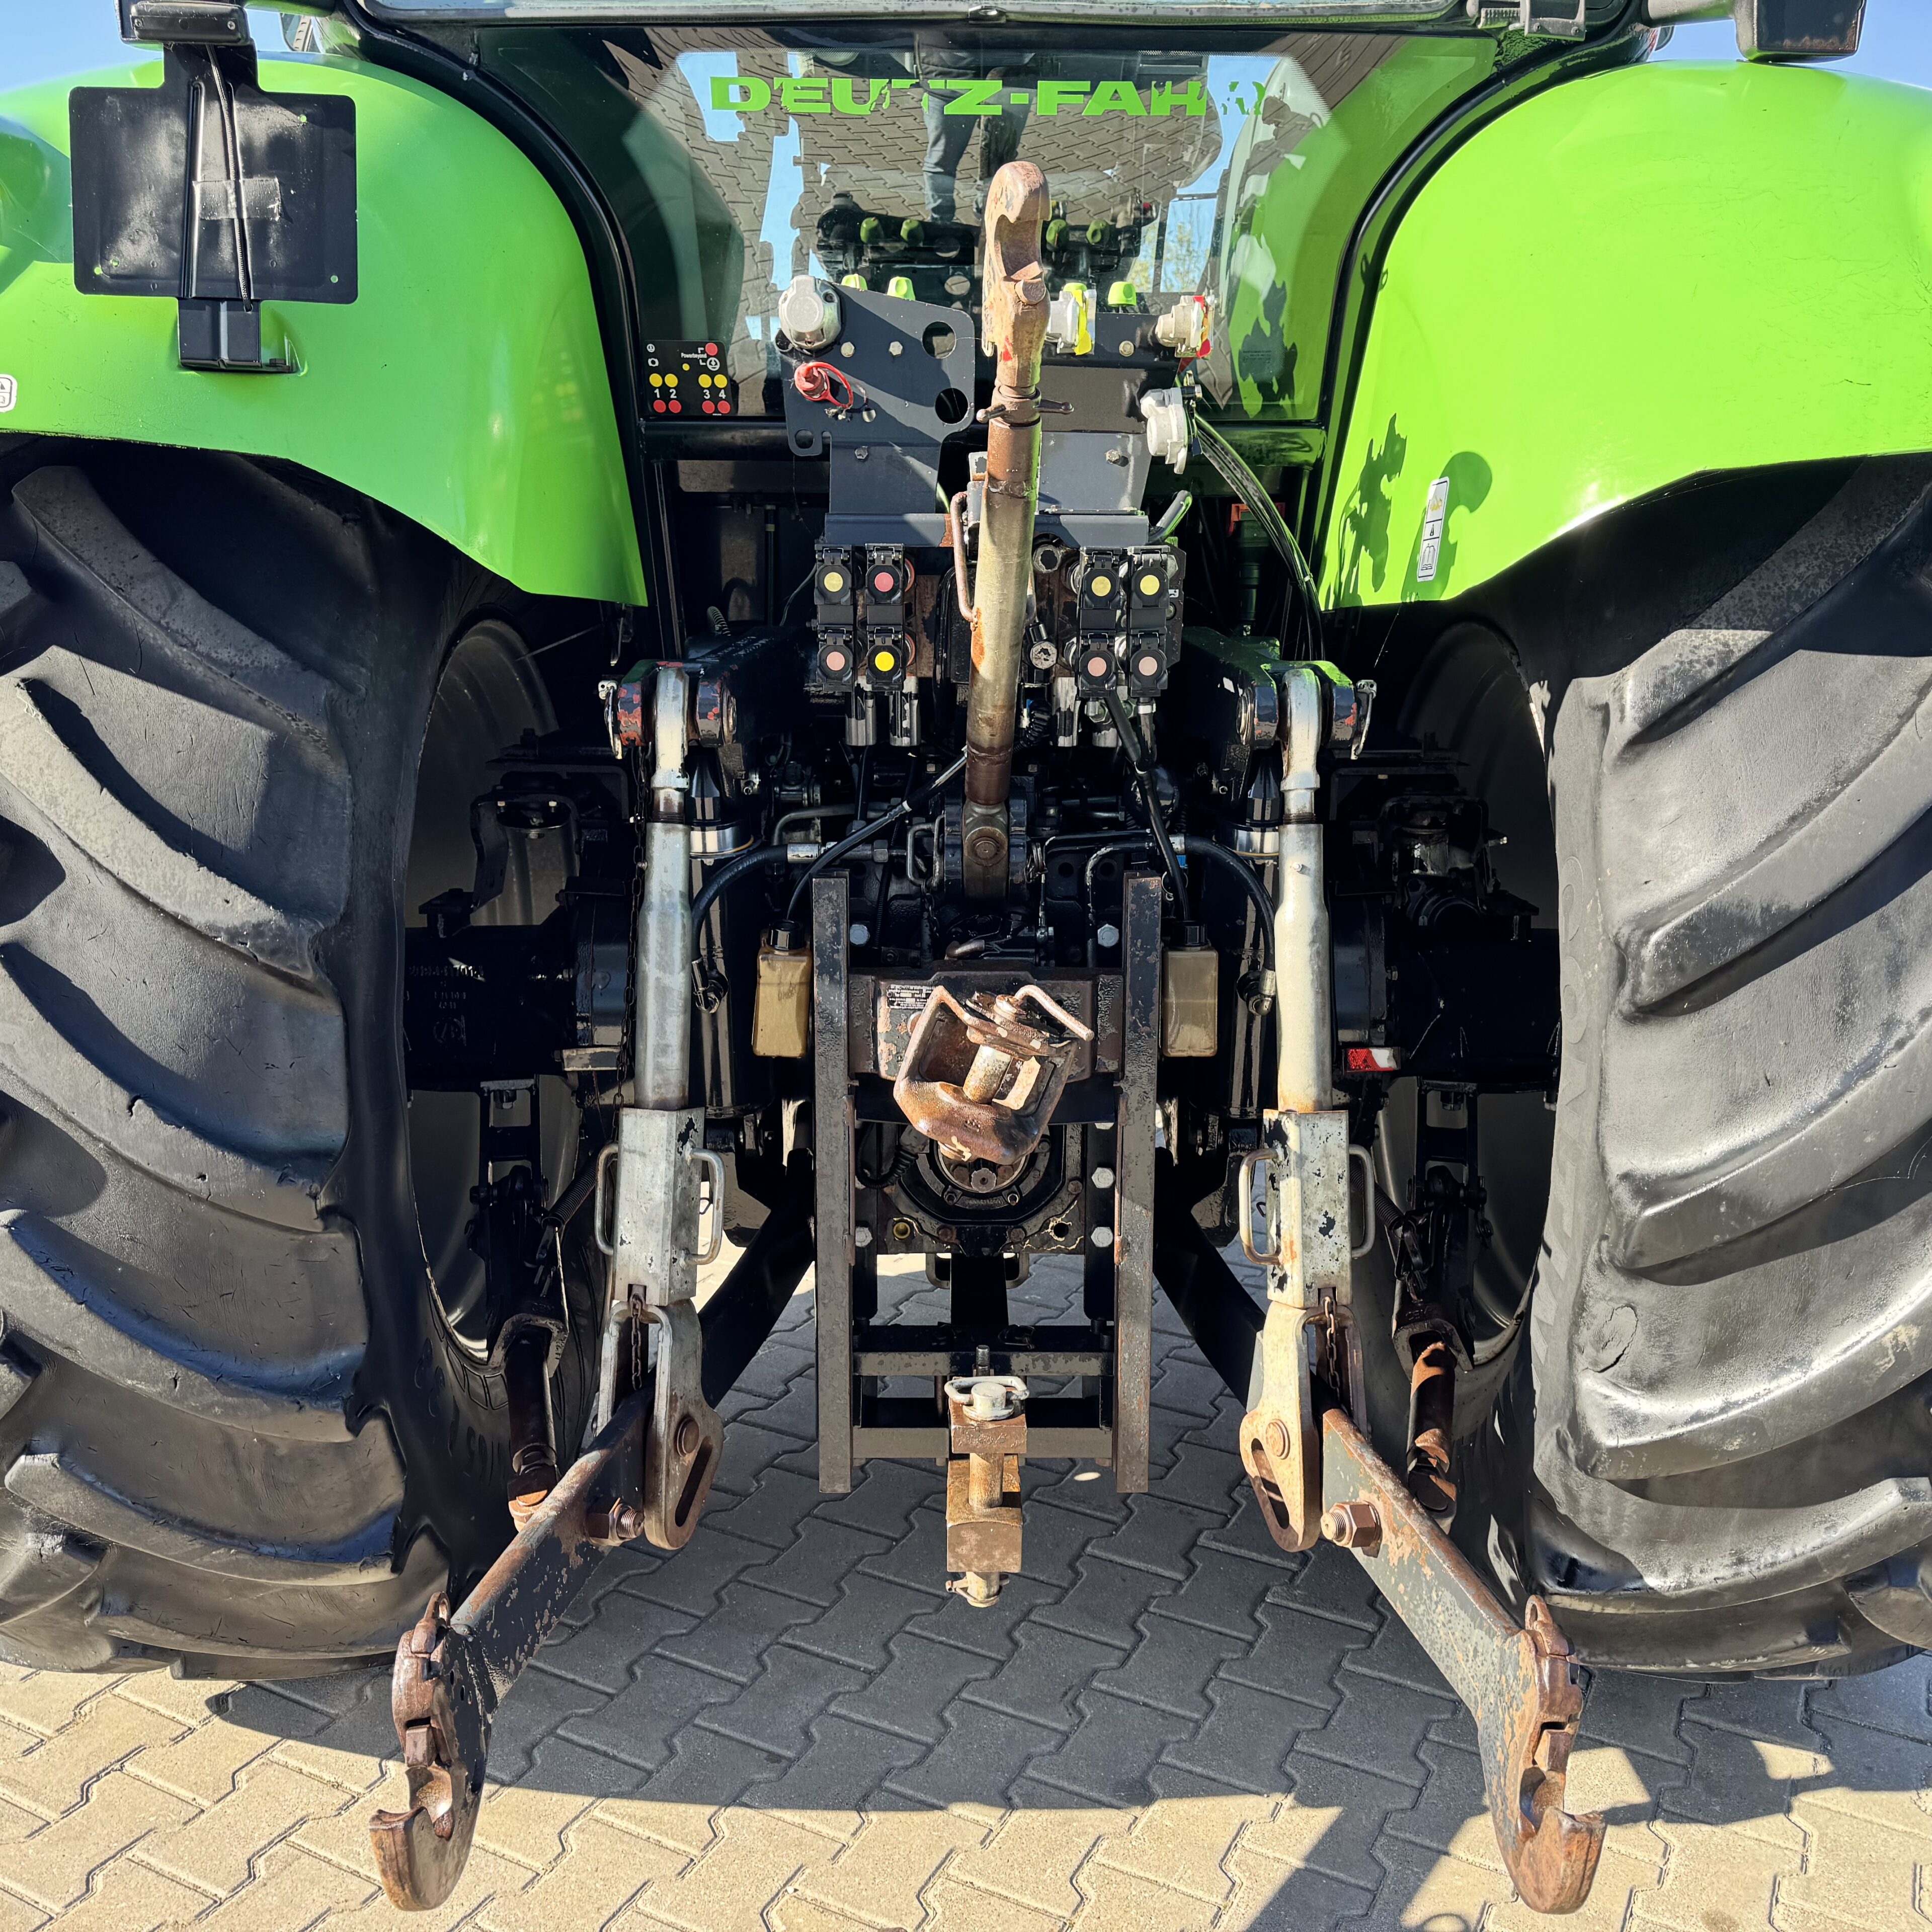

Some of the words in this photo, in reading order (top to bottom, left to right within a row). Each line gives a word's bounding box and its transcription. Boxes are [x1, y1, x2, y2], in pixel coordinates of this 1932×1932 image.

[654, 388, 660, 398] 1
[669, 388, 677, 398] 2
[703, 389, 710, 399] 3
[718, 389, 726, 399] 4
